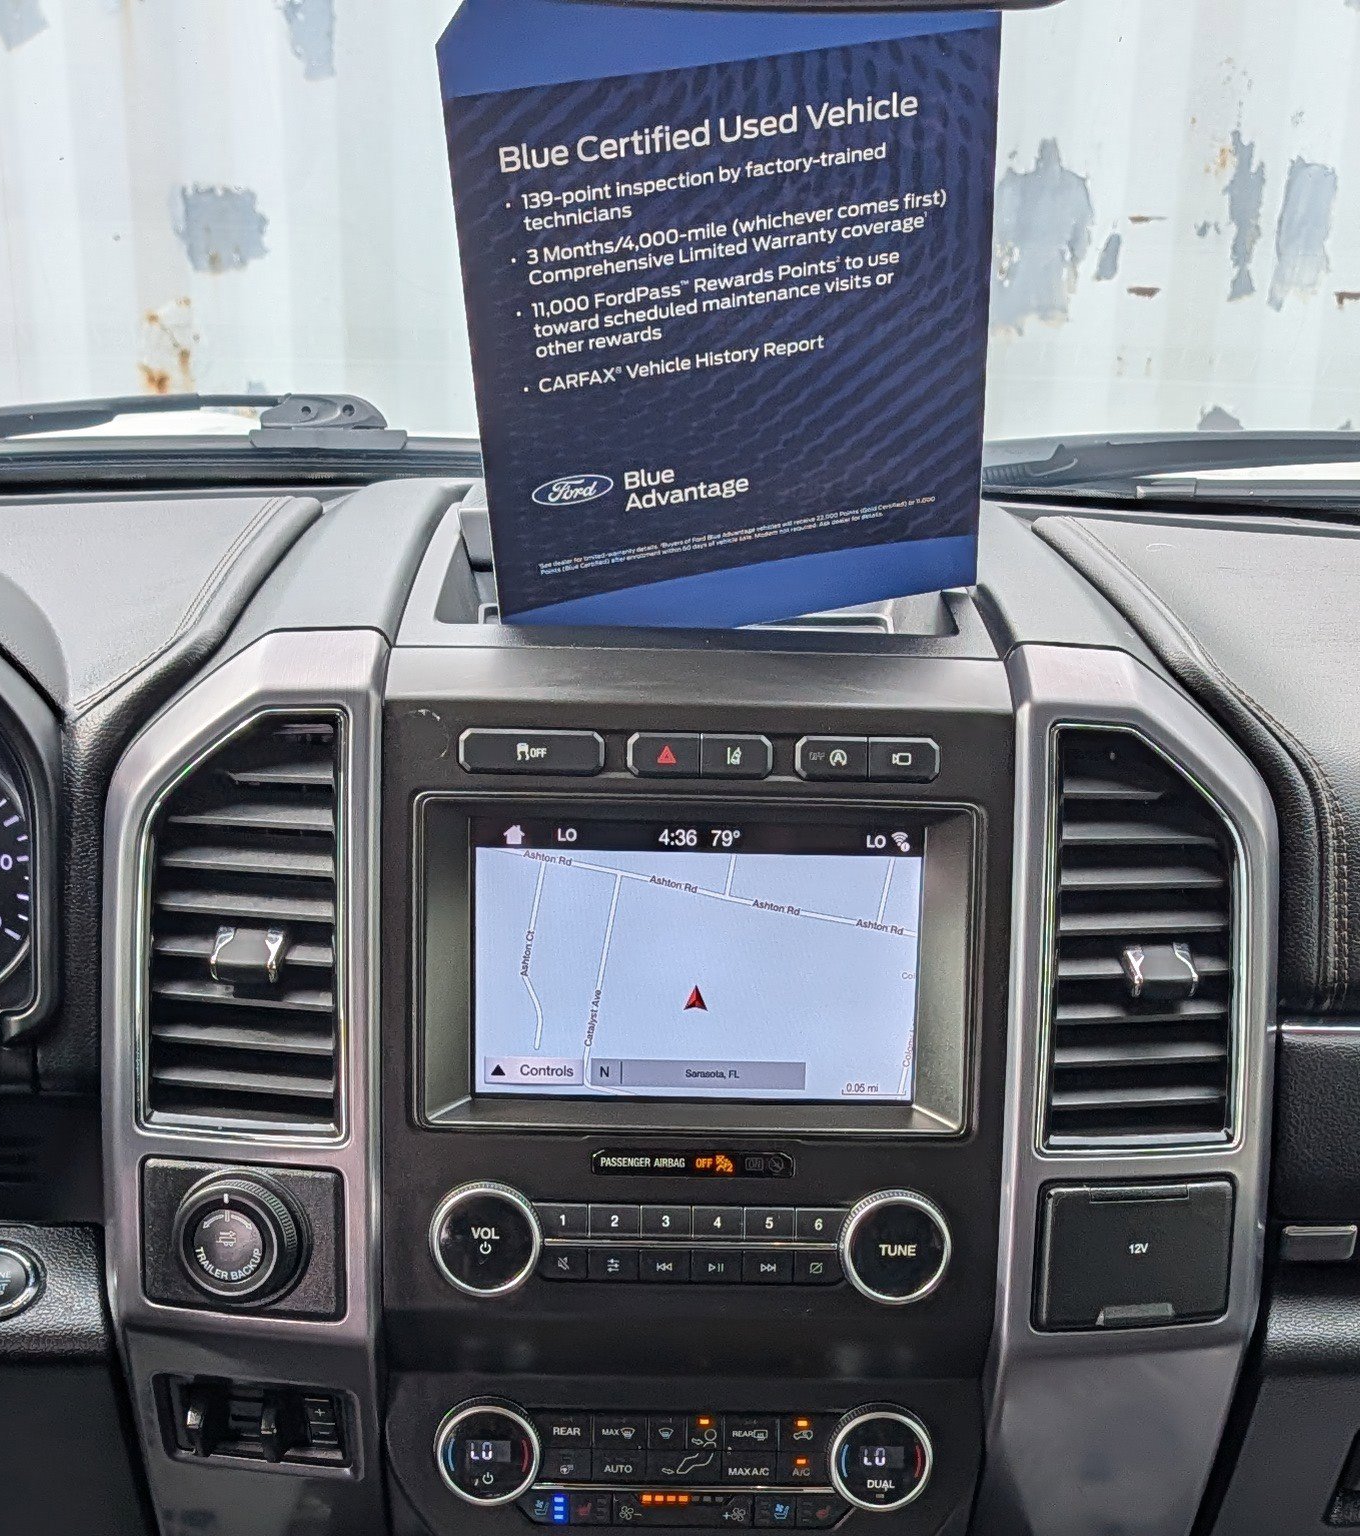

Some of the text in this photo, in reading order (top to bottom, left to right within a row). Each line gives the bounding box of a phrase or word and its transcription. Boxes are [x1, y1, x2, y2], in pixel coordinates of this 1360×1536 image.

[498, 91, 919, 174] Blue Certified Used Vehicle
[521, 141, 887, 210] 139-point inspection by factory-trained
[523, 203, 633, 232] technicians
[526, 188, 947, 265] 3 Months/4,000-mile (whichever comes first)
[528, 251, 675, 286] Comprehensive
[678, 240, 748, 264] Limited
[751, 226, 838, 250] Warranty
[530, 295, 590, 318] 11,000
[693, 267, 775, 294] Rewards
[844, 255, 864, 270] to
[867, 251, 900, 268] use
[533, 270, 895, 339] toward scheduled maintenance visits or
[535, 325, 663, 359] other rewards
[625, 356, 692, 380] Vehicle
[695, 345, 760, 370] History
[763, 334, 825, 358] Report
[623, 468, 676, 491] Blue
[625, 477, 750, 512] Advantage
[529, 746, 547, 758] OFF
[557, 828, 578, 842] LO
[657, 828, 698, 846] 4:36
[866, 834, 887, 849] LO
[523, 849, 572, 867] Ashton Rd
[649, 874, 698, 894] Ashton Rd
[752, 898, 800, 916] Ashton Rd
[855, 918, 904, 936] Ashton Rd
[520, 929, 536, 977] Ashton Ct
[583, 988, 602, 1047] Catalyst Ave
[519, 1064, 574, 1077] Controls
[599, 1066, 610, 1078] N
[684, 1069, 740, 1080] Sarasota, FL
[846, 1082, 879, 1093] 0.05 mi
[600, 1156, 713, 1169] PASSENGER AIRBAG OFF
[558, 1214, 567, 1227] 1
[610, 1215, 619, 1228] 2
[661, 1215, 671, 1228] 3
[712, 1216, 722, 1229] 4
[764, 1217, 774, 1229] 5
[814, 1218, 823, 1231] 6
[471, 1226, 500, 1241] VOL
[879, 1243, 917, 1257] TUNE
[1128, 1242, 1149, 1255] 12V
[195, 1246, 262, 1281] TRAILER BACKUP
[552, 1426, 581, 1437] REAR
[601, 1428, 620, 1437] MAX
[731, 1430, 753, 1438] REAR
[603, 1464, 633, 1474] AUTO
[728, 1467, 770, 1477] MAX A/C
[792, 1467, 811, 1477] A/C
[866, 1479, 895, 1489] DUAL
